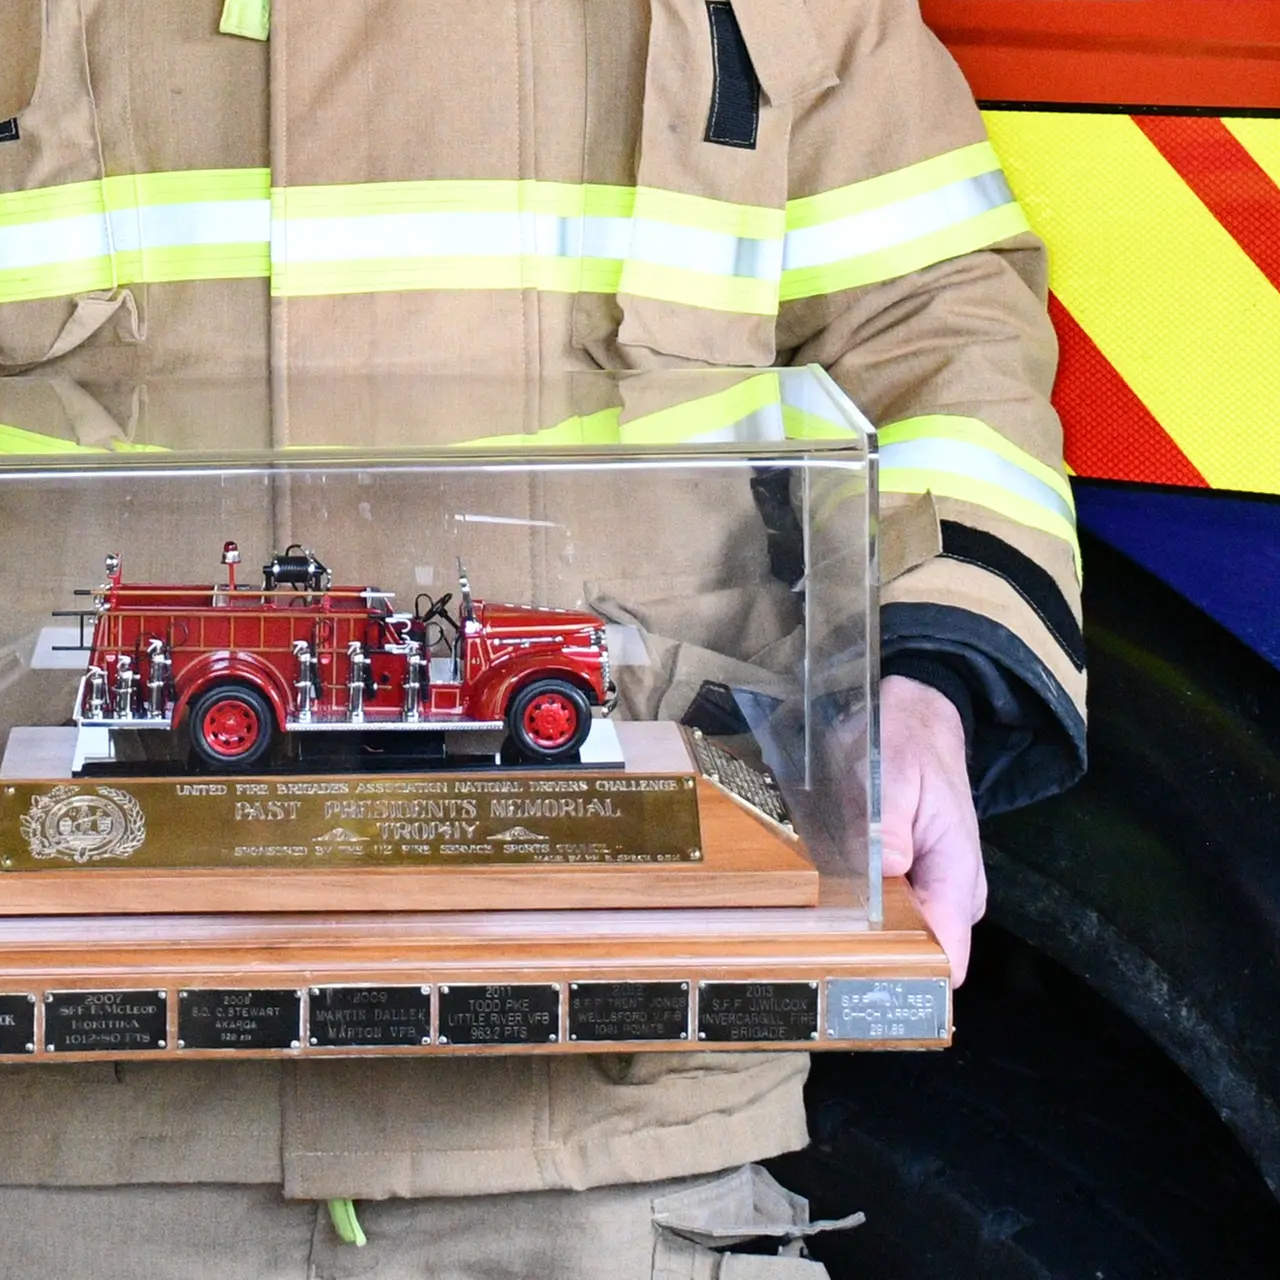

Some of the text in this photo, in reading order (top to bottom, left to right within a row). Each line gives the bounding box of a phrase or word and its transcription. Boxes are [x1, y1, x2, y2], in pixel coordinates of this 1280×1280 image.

[176, 779, 679, 796] UNITED FIRE BRIGADES ASSOCIATION NATIONAL DRIVERS CHALLENGE
[235, 797, 621, 821] PAST PRESIDENTS MEMORIAL
[376, 820, 480, 841] TROPHY
[315, 845, 332, 855] BY
[401, 843, 432, 855] FIRE
[440, 843, 493, 854] SERVICE
[503, 842, 551, 854] SPORTS
[352, 991, 388, 1003] 2009
[485, 986, 513, 998] 2011
[745, 984, 774, 998] 2013
[84, 994, 123, 1006] 2007
[468, 999, 501, 1012] TODD
[649, 996, 687, 1009] JONES
[315, 1010, 367, 1021] MARTIN
[448, 1011, 550, 1026] LITTLE RIVER VFB
[577, 1011, 648, 1022] WELLSFORD
[790, 1012, 817, 1025] FIRE
[389, 1026, 416, 1038] VFB
[504, 1026, 528, 1039] PTS
[622, 1023, 665, 1035] POINTS
[731, 1026, 788, 1039] BRIGADE
